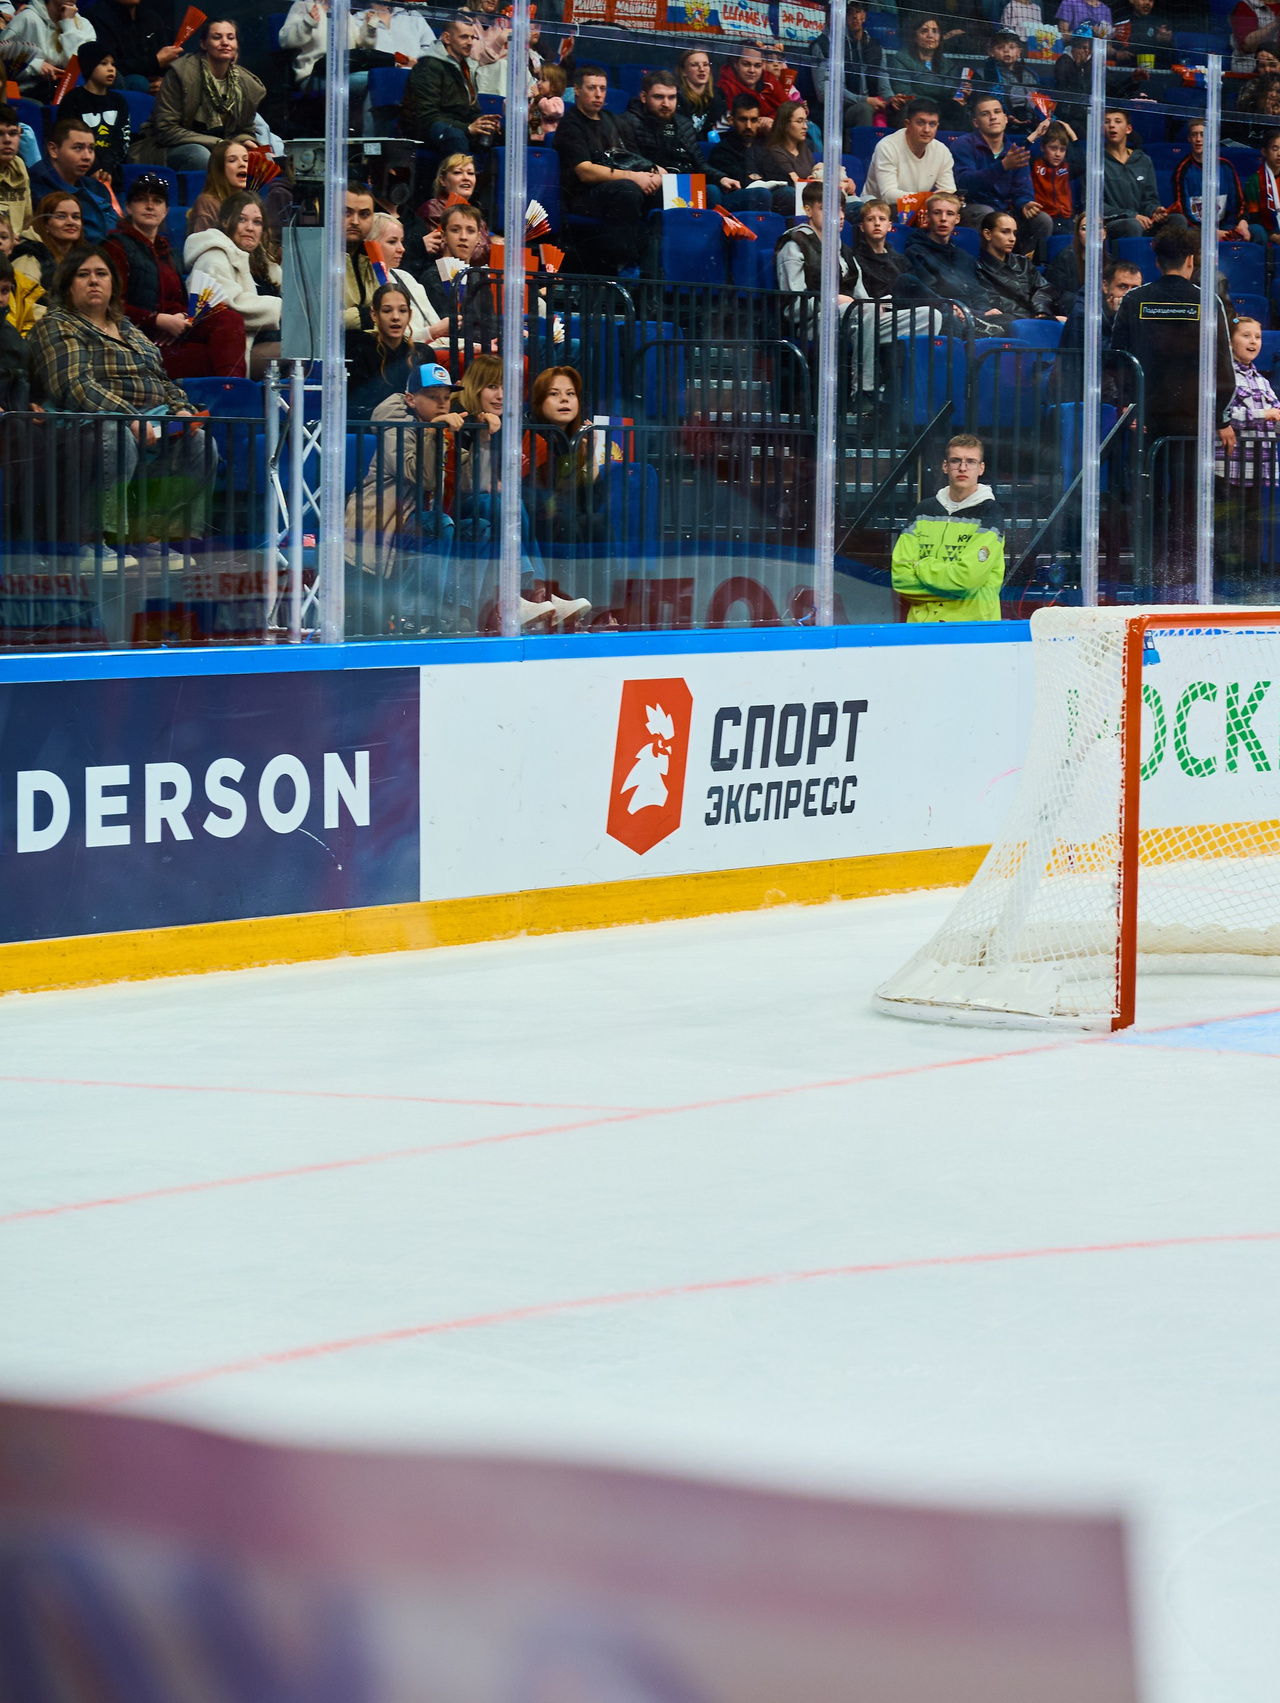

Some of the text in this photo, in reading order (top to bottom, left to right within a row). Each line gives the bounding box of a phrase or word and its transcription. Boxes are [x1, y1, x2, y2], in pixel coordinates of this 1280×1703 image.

[711, 700, 868, 772] СПОРТ
[17, 751, 370, 853] DERSON
[704, 775, 858, 826] ЭКСПРЕСС
